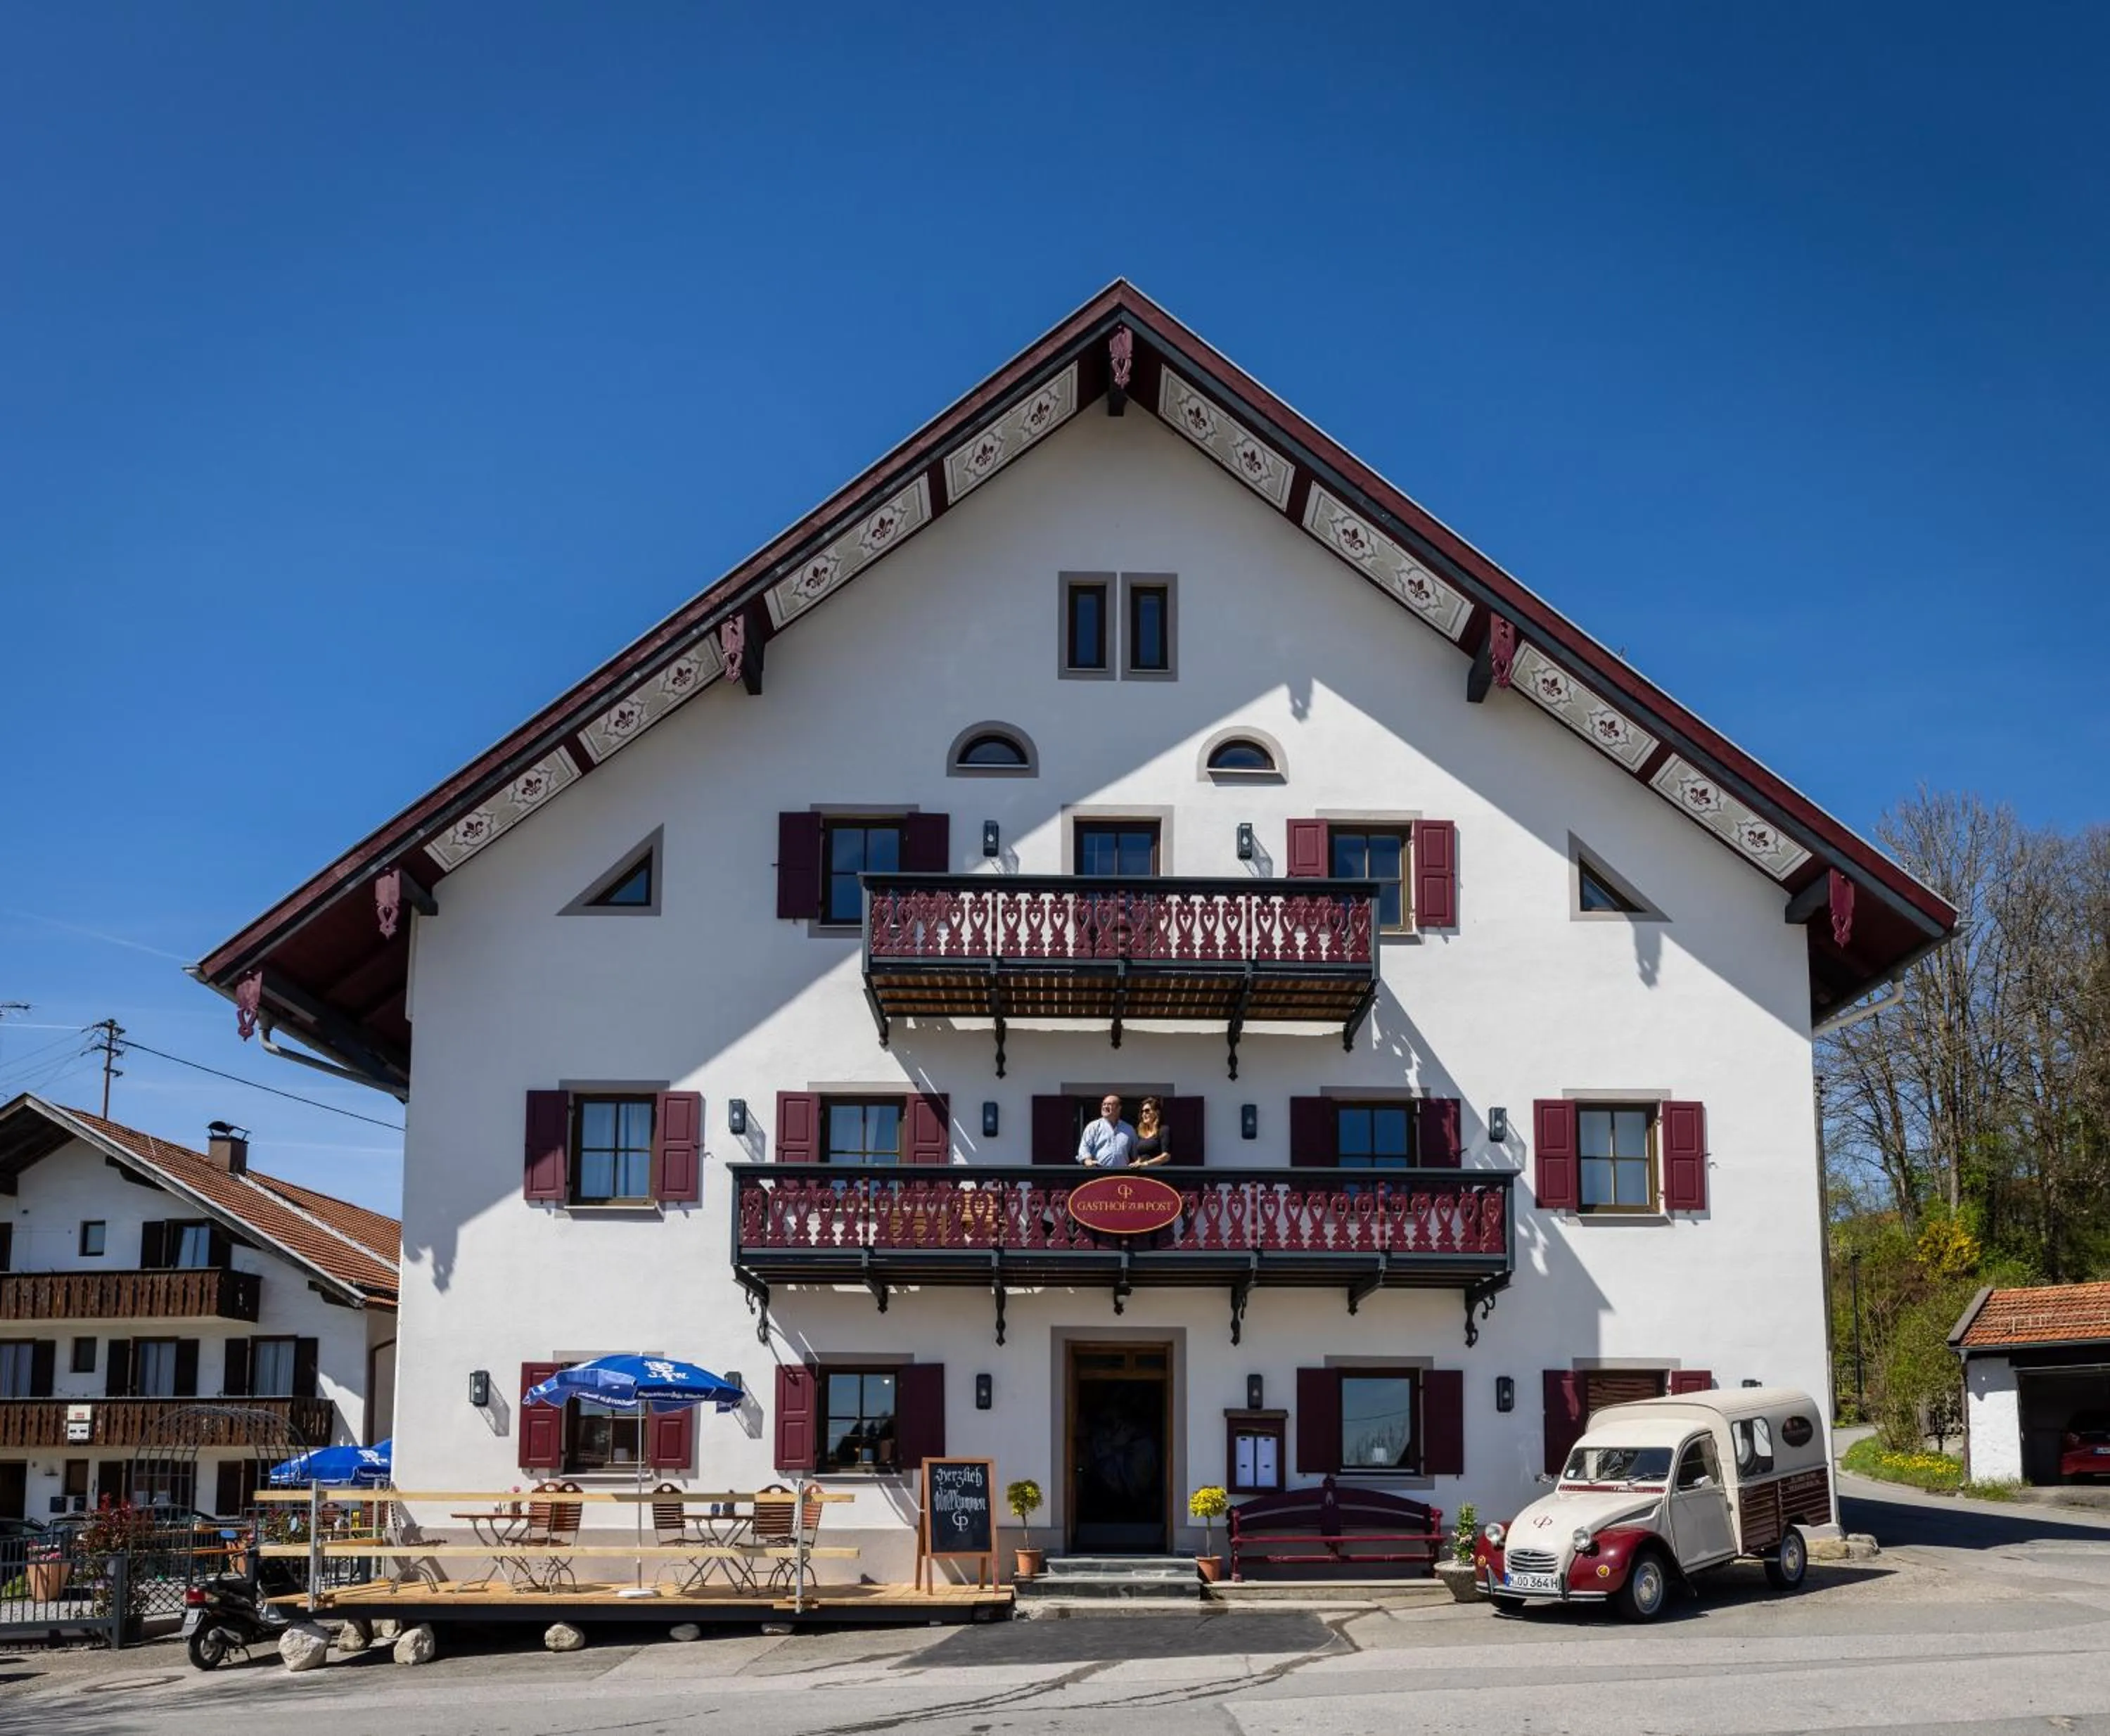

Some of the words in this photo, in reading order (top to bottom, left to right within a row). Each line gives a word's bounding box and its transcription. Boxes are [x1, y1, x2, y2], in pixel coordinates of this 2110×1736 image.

[1077, 1201, 1125, 1211] GASTHOF
[1146, 1201, 1172, 1211] POST
[934, 1466, 983, 1488] Herzlich
